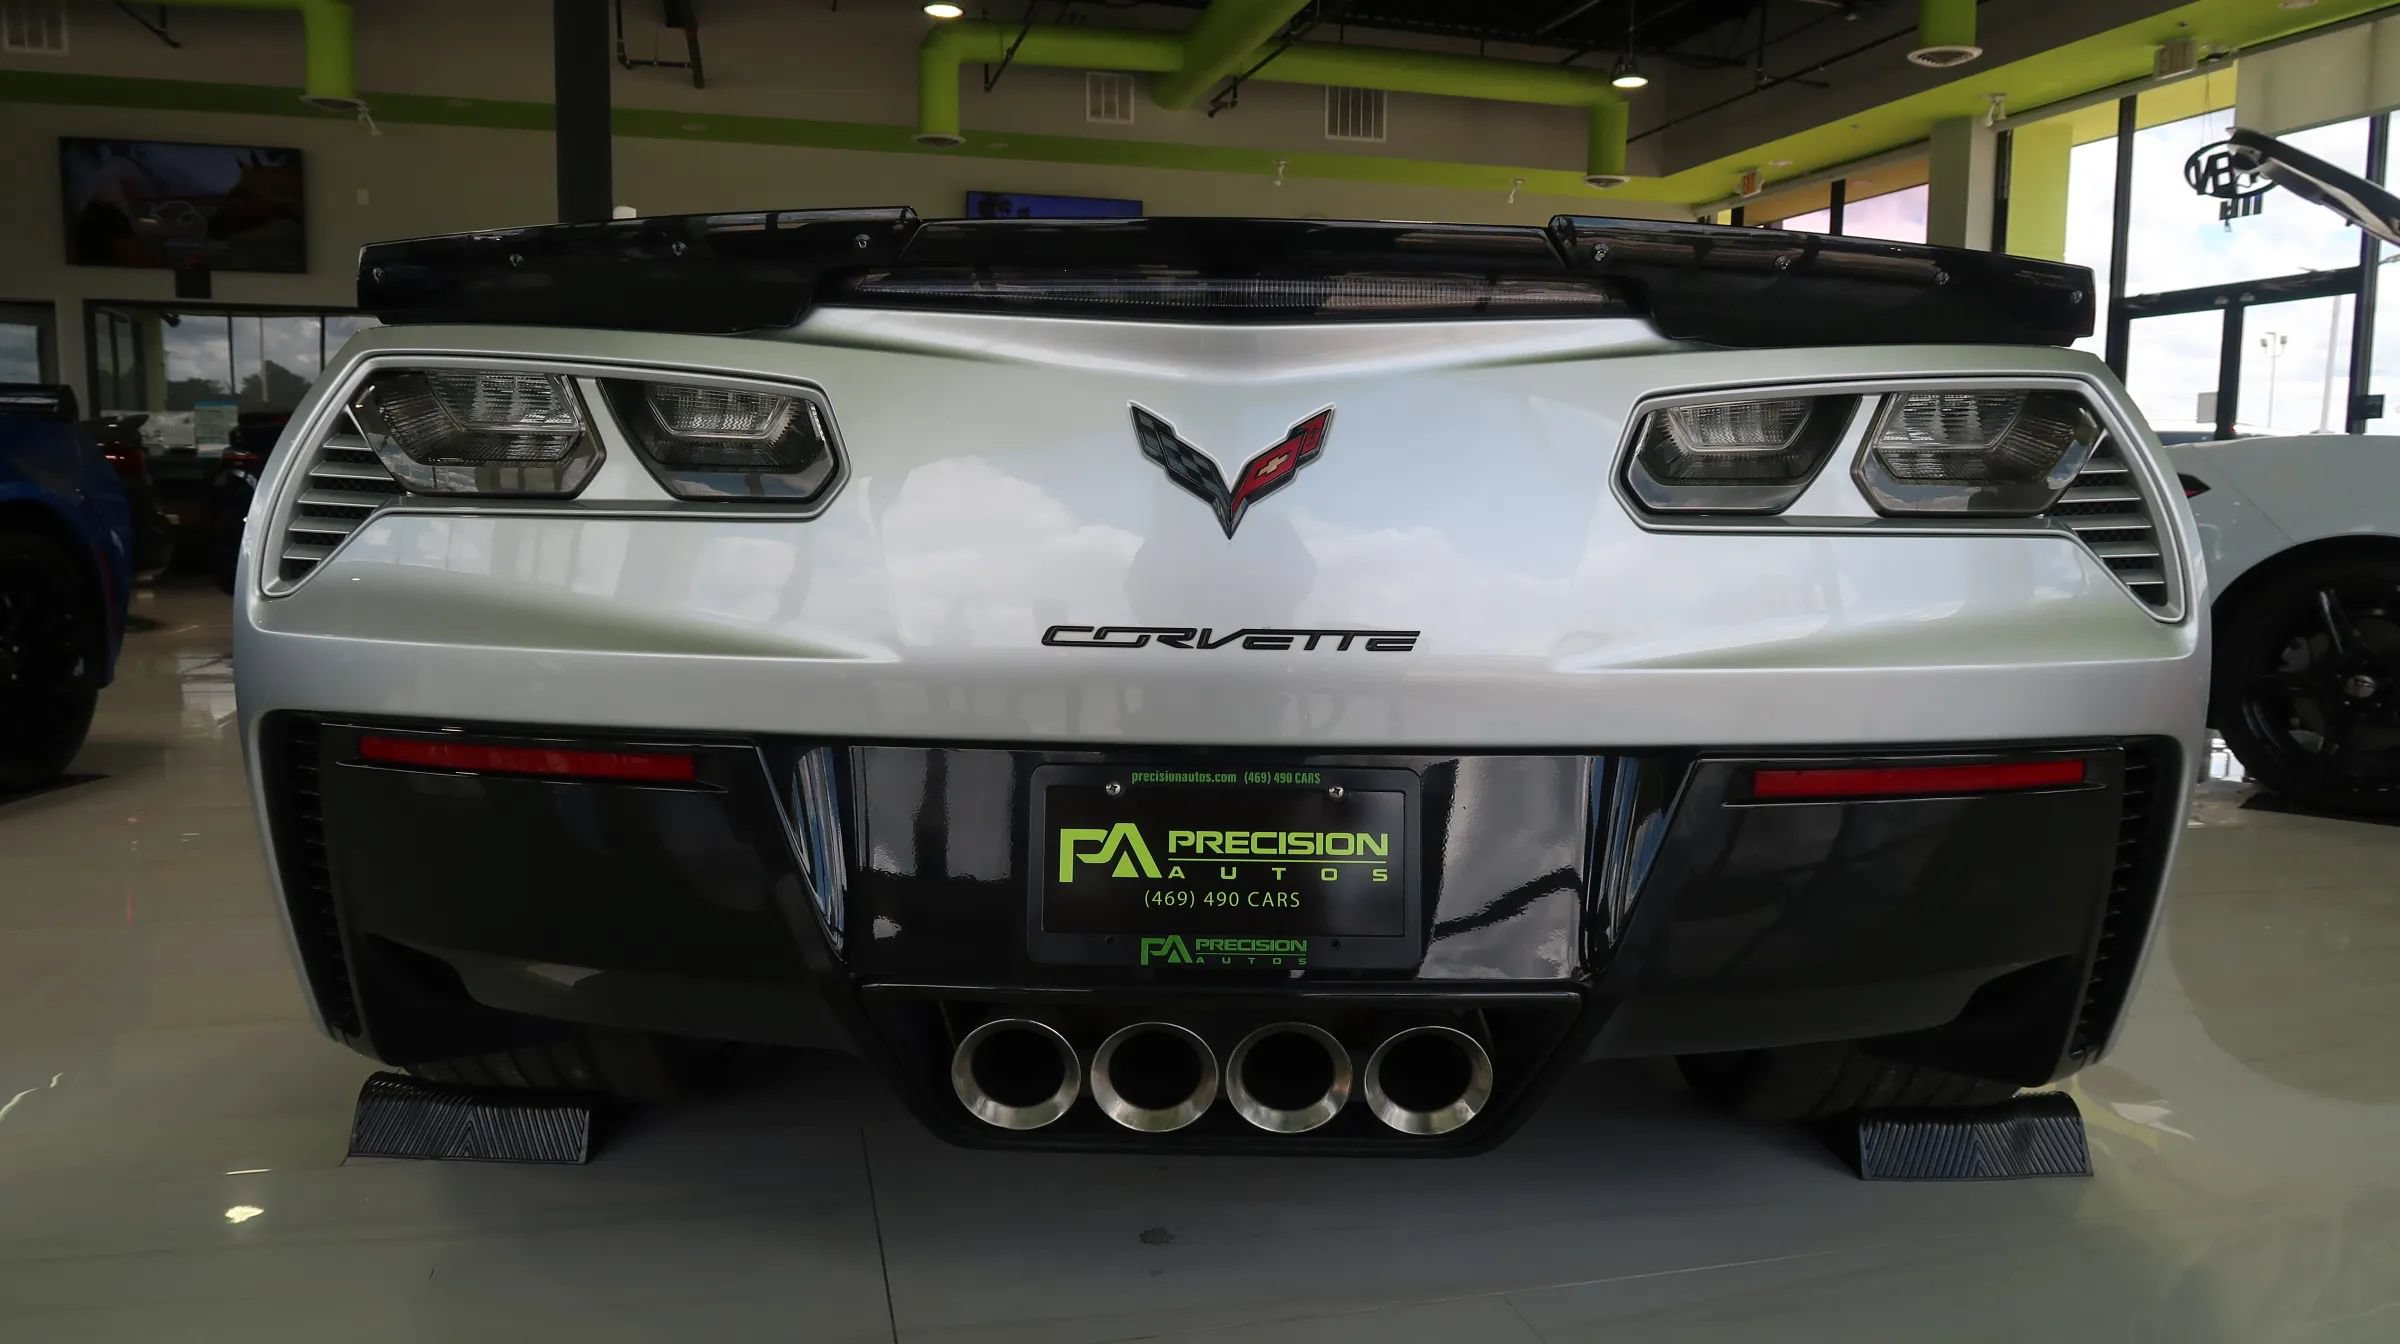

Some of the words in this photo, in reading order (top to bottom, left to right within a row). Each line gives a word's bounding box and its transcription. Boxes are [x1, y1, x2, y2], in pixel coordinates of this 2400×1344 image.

[1041, 625, 1421, 651] CORVETTE
[1131, 771, 1238, 785] precisionautos.com
[1244, 771, 1272, 785] (469)
[1273, 772, 1293, 785] 490
[1294, 772, 1321, 785] CARS
[1168, 830, 1389, 857] PRECISION
[1168, 866, 1389, 882] AUTOS
[1144, 890, 1196, 909] (469)
[1203, 891, 1239, 908] 490
[1247, 891, 1301, 908] CARS
[1195, 938, 1308, 953] PRECISION
[1195, 955, 1308, 966] AUTOS
